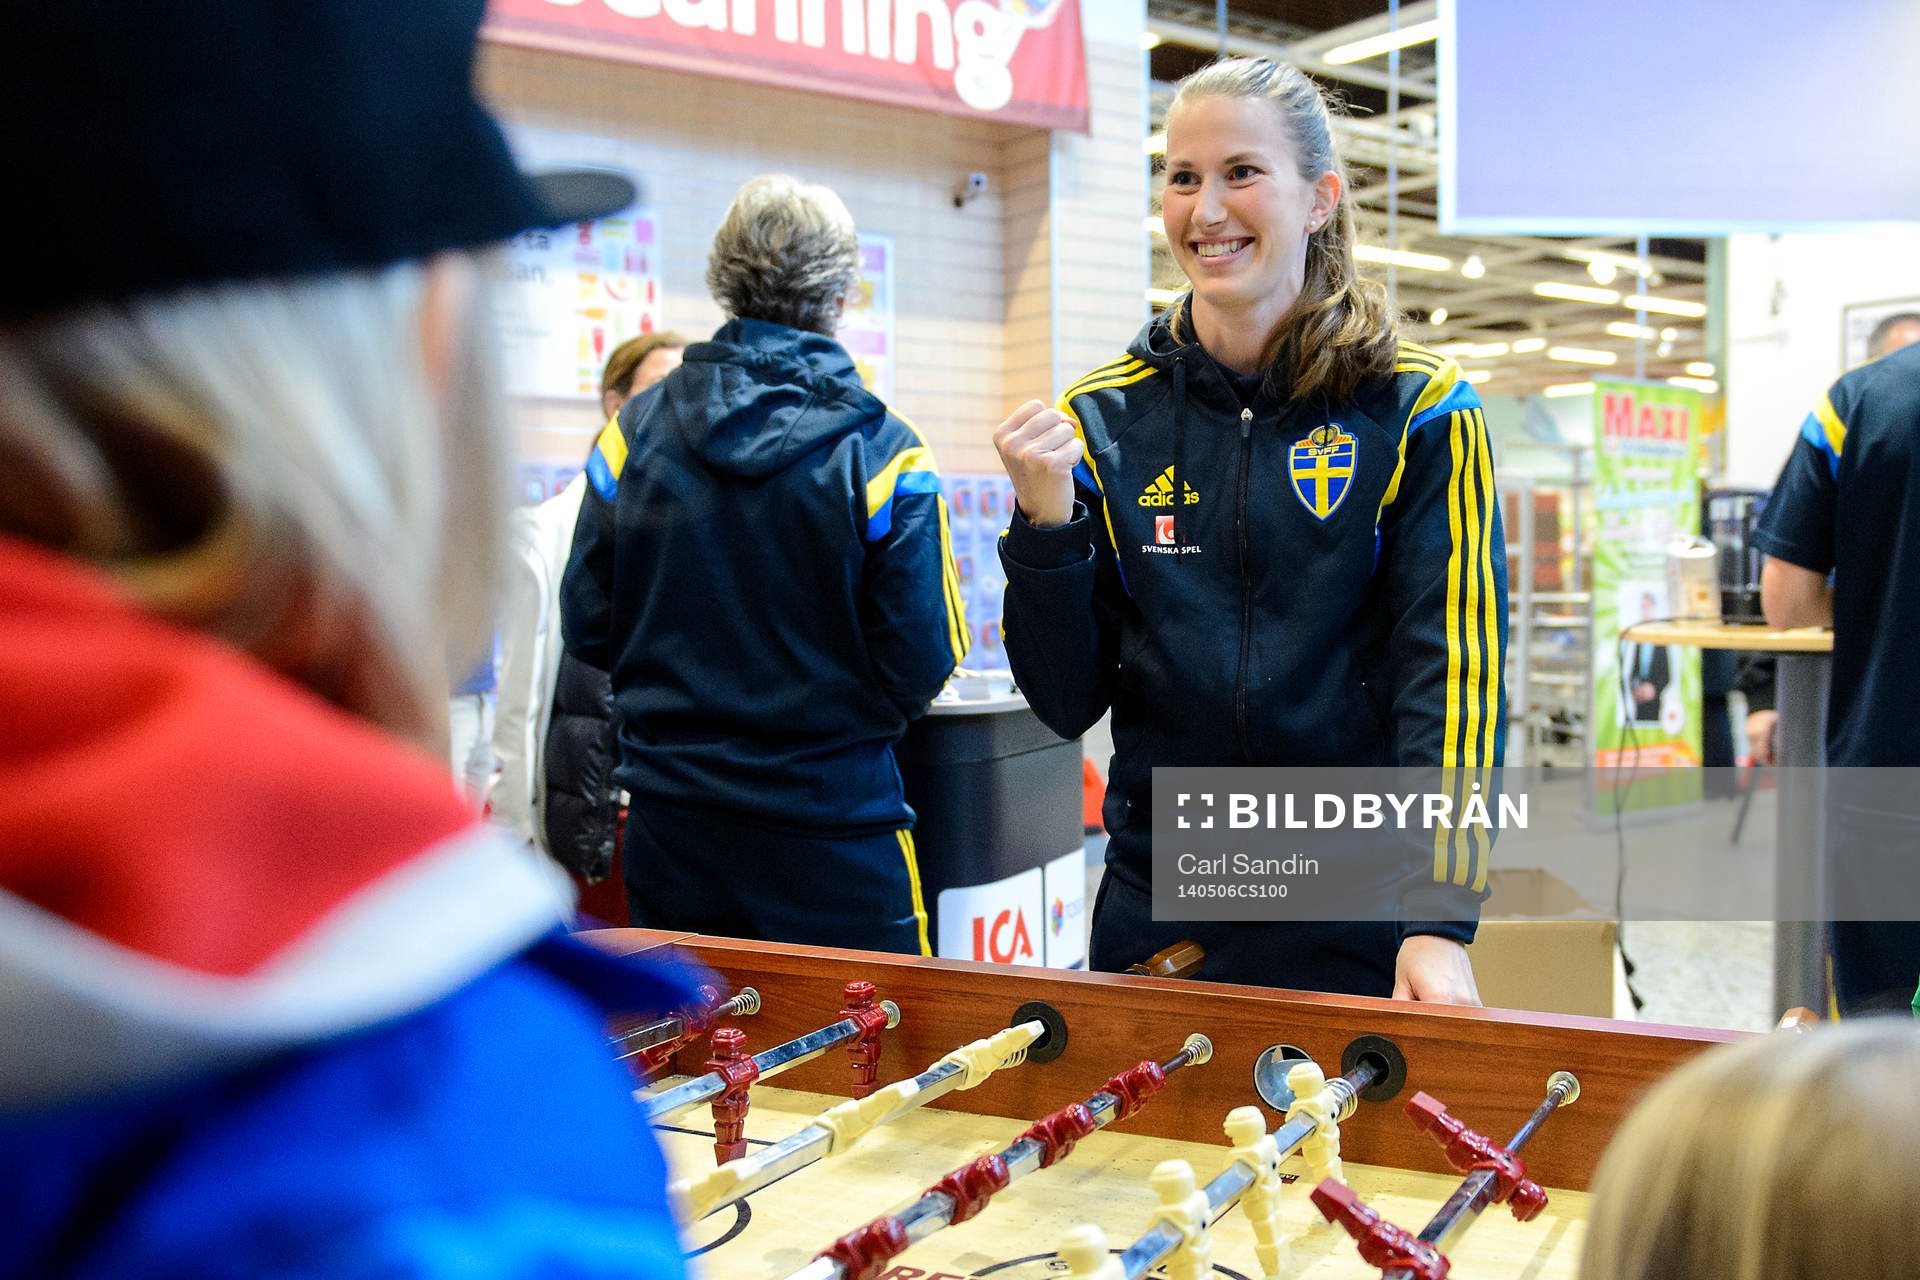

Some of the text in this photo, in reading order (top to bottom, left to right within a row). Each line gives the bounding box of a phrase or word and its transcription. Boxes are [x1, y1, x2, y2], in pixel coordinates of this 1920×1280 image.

[545, 0, 1014, 110] nning
[1308, 446, 1340, 455] SvFF
[1141, 545, 1202, 554] SVENSKA SPEL
[972, 904, 1034, 964] ICA
